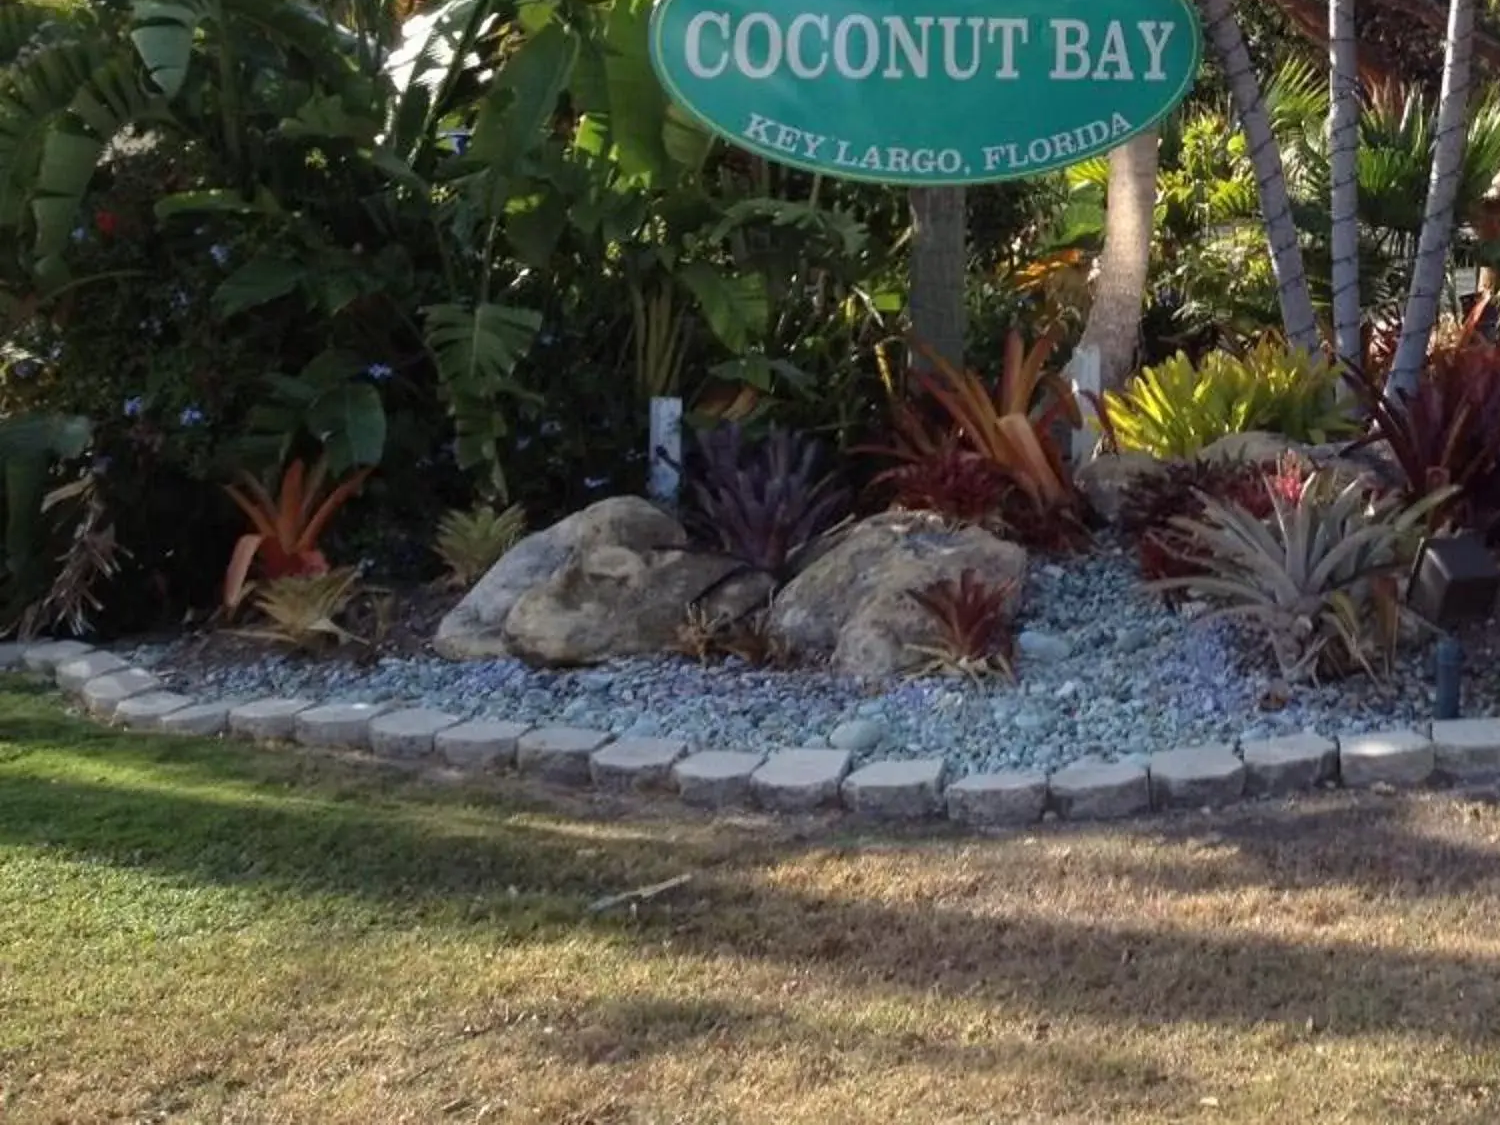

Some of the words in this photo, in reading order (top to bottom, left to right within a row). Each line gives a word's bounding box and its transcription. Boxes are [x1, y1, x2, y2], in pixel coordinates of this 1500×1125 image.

[684, 11, 1029, 80] COCONUT
[1049, 18, 1175, 81] BAY
[744, 112, 827, 159] KEY
[835, 141, 971, 174] LARGO,
[982, 112, 1132, 172] FLORIDA
